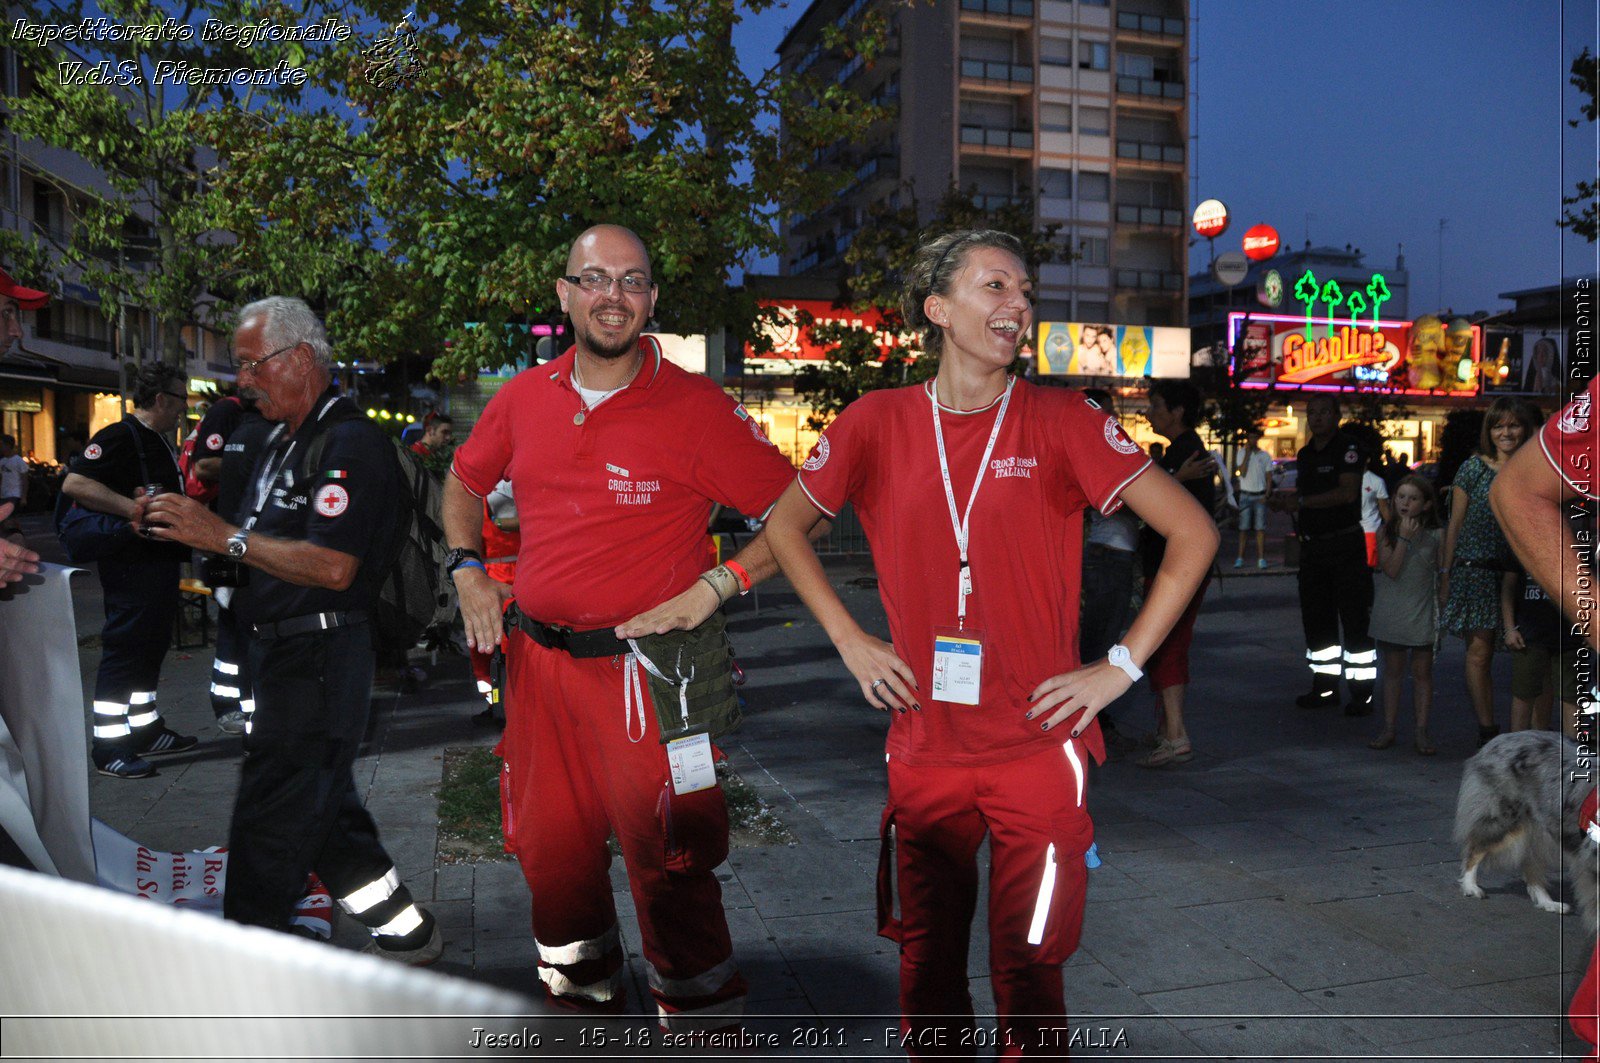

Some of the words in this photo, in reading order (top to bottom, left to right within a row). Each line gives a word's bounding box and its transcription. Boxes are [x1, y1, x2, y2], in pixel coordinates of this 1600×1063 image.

[1283, 326, 1388, 374] Gasoline
[991, 457, 1015, 469] CROCE
[995, 468, 1031, 478] ITALIANA
[608, 479, 633, 492] CROCE
[636, 480, 660, 492] ROSSA
[616, 493, 651, 505] ITALIANA
[1525, 589, 1540, 600] LOS
